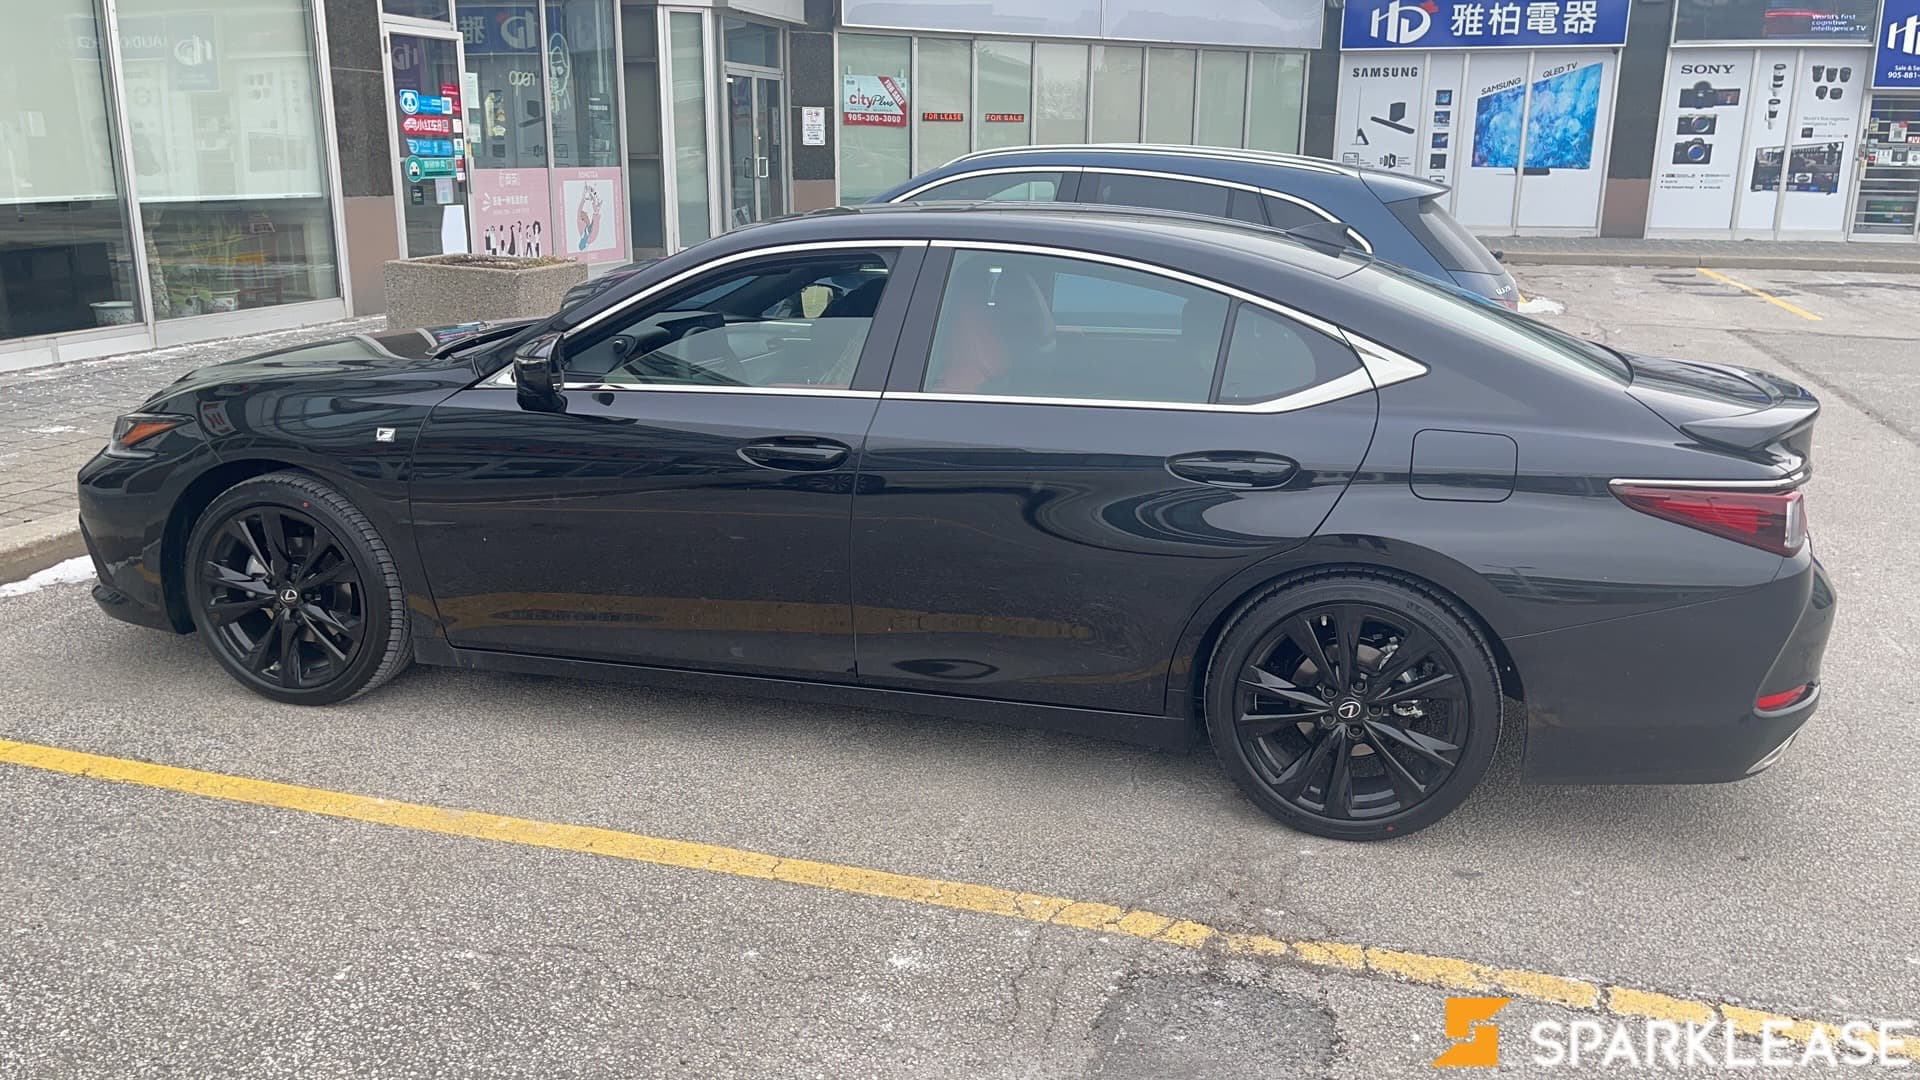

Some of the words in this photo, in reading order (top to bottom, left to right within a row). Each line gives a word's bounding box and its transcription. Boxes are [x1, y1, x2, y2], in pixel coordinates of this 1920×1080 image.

[1450, 1, 1598, 36] 雅柏電器
[1352, 67, 1418, 78] SAMSUNG
[1480, 77, 1522, 95] SAMSUNG
[1542, 65, 1565, 79] QLED
[1566, 62, 1579, 72] TV
[1681, 64, 1735, 75] SONY
[509, 70, 536, 96] open
[940, 113, 961, 121] LEASE
